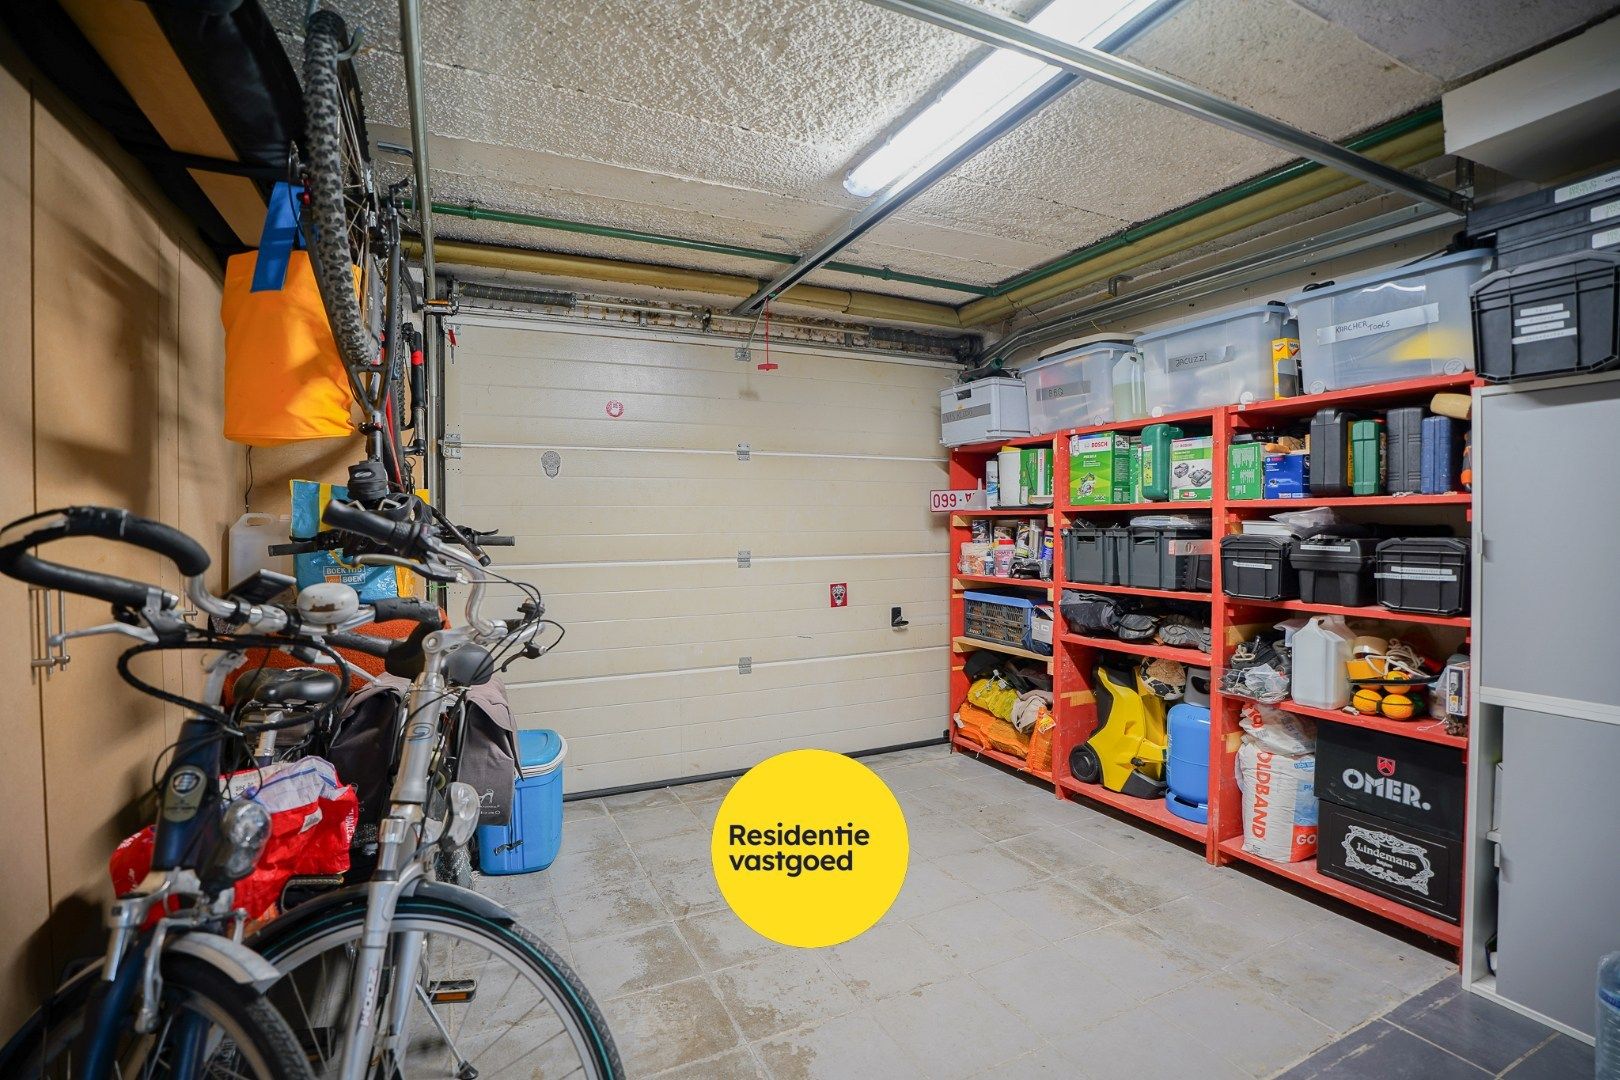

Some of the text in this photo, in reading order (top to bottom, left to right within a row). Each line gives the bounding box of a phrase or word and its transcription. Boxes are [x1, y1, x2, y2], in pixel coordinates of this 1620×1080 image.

[1367, 321, 1390, 332] TOOLS
[326, 567, 346, 575] BOEK
[342, 575, 363, 583] BOEK
[1356, 842, 1417, 870] Lindemans
